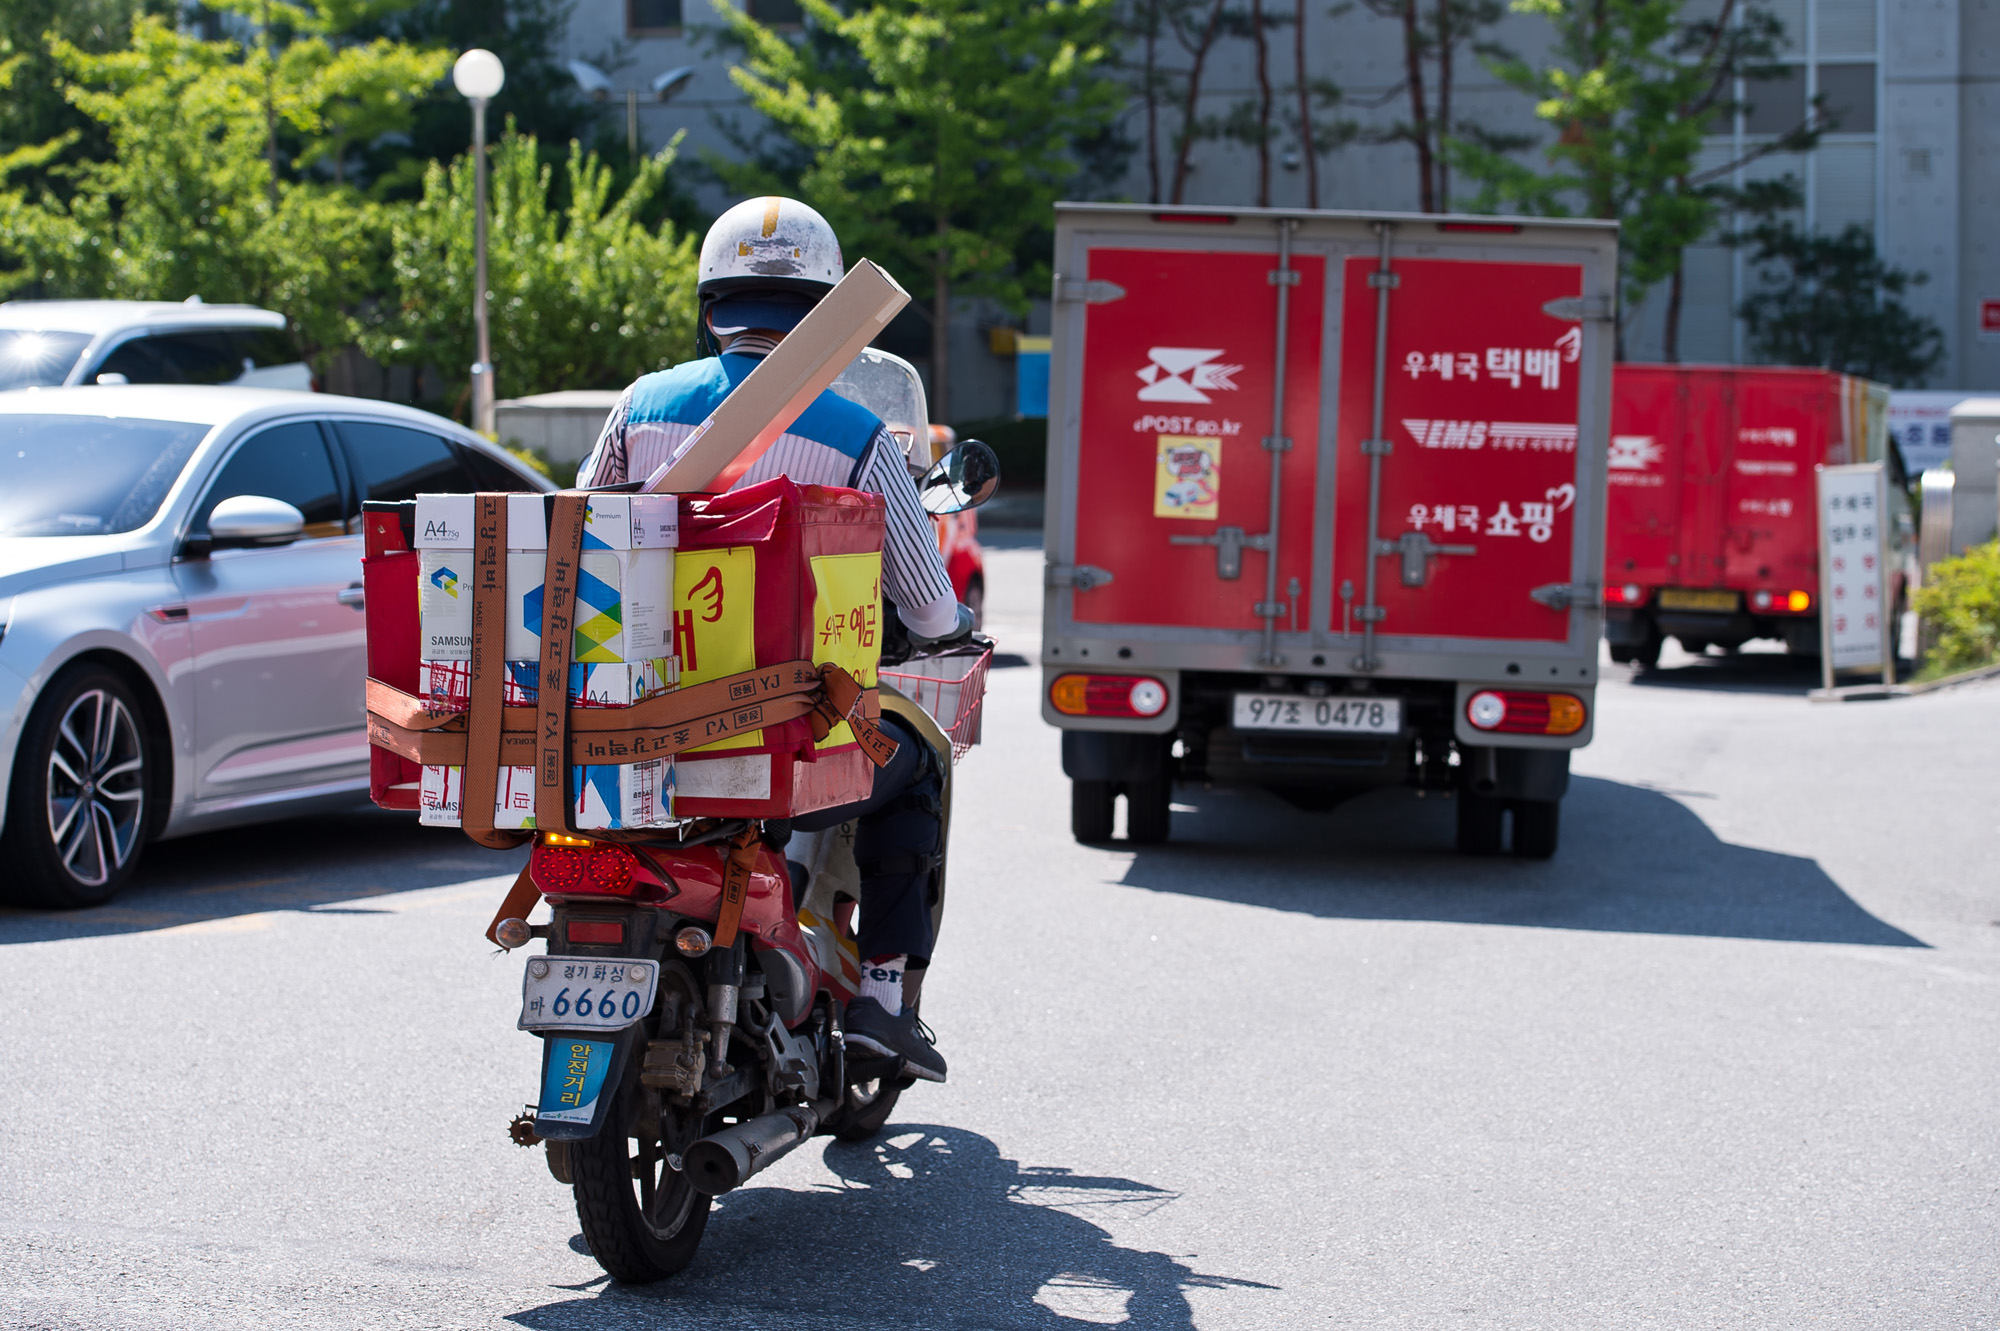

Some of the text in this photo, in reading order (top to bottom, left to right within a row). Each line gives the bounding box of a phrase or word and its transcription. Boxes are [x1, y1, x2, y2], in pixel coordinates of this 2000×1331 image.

[1402, 347, 1560, 389] 우체국 택배
[1133, 415, 1243, 435] ePOST.go.kr
[1425, 420, 1487, 449] EMS
[424, 520, 447, 537] A4
[1406, 501, 1555, 543] 우체국 쇼핑
[547, 557, 571, 691] 초고강력바
[473, 601, 483, 681] MADE IN KOREA
[760, 674, 780, 691] YJ
[545, 711, 559, 740] YJ
[705, 717, 729, 736] YJ
[1249, 699, 1385, 727] 97조 0478
[584, 728, 690, 757] 초고강력바
[563, 964, 625, 983] 경기 화성
[530, 987, 640, 1019] 마 6660
[560, 1044, 593, 1107] 안전거리
